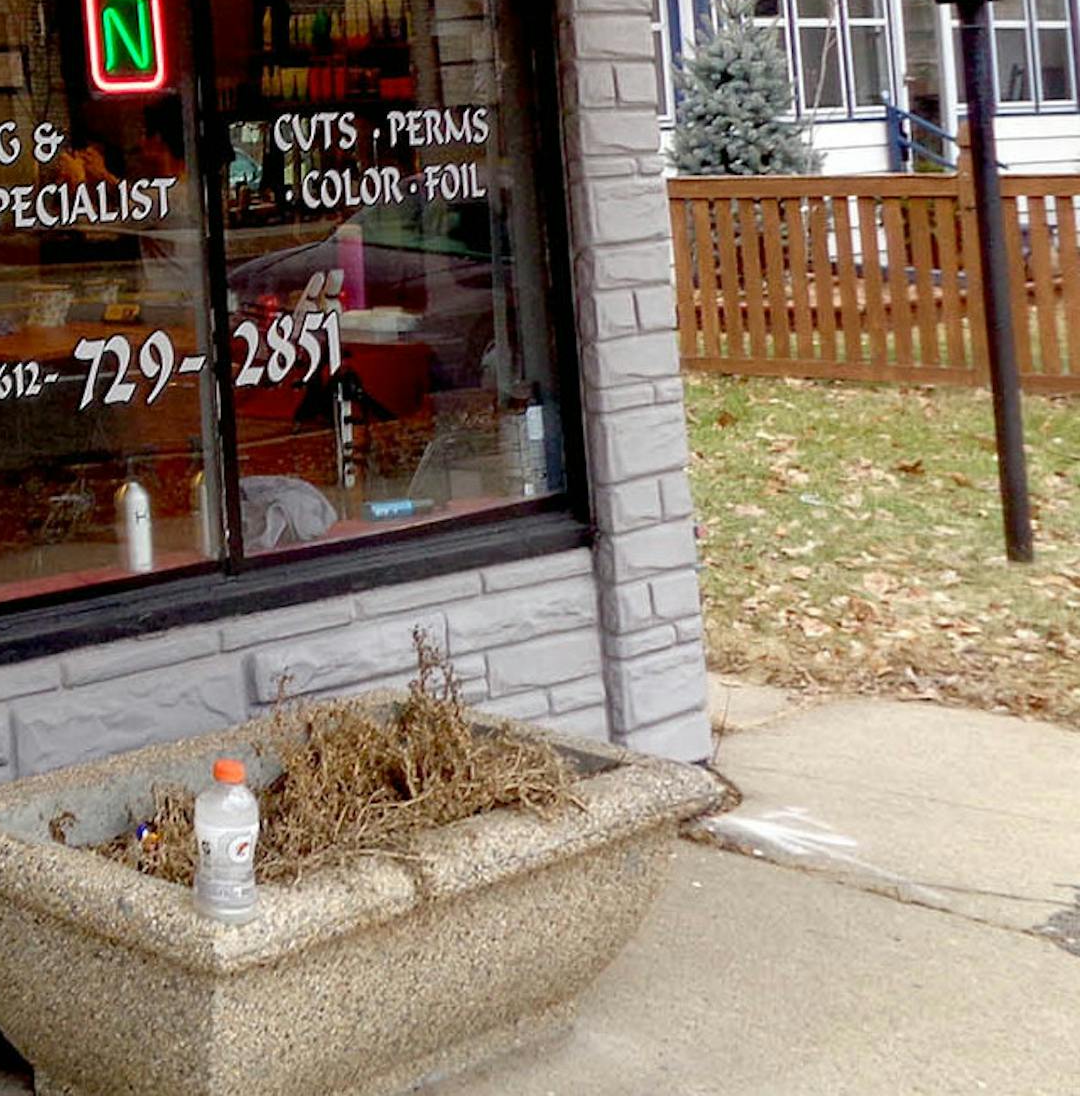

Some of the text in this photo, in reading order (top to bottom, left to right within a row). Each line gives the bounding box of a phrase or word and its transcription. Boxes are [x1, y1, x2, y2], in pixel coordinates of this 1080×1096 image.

[34, 122, 64, 163] &
[274, 107, 489, 152] CUTS PERMS
[302, 162, 487, 209] COLOR FOIL
[234, 311, 342, 387] 2851
